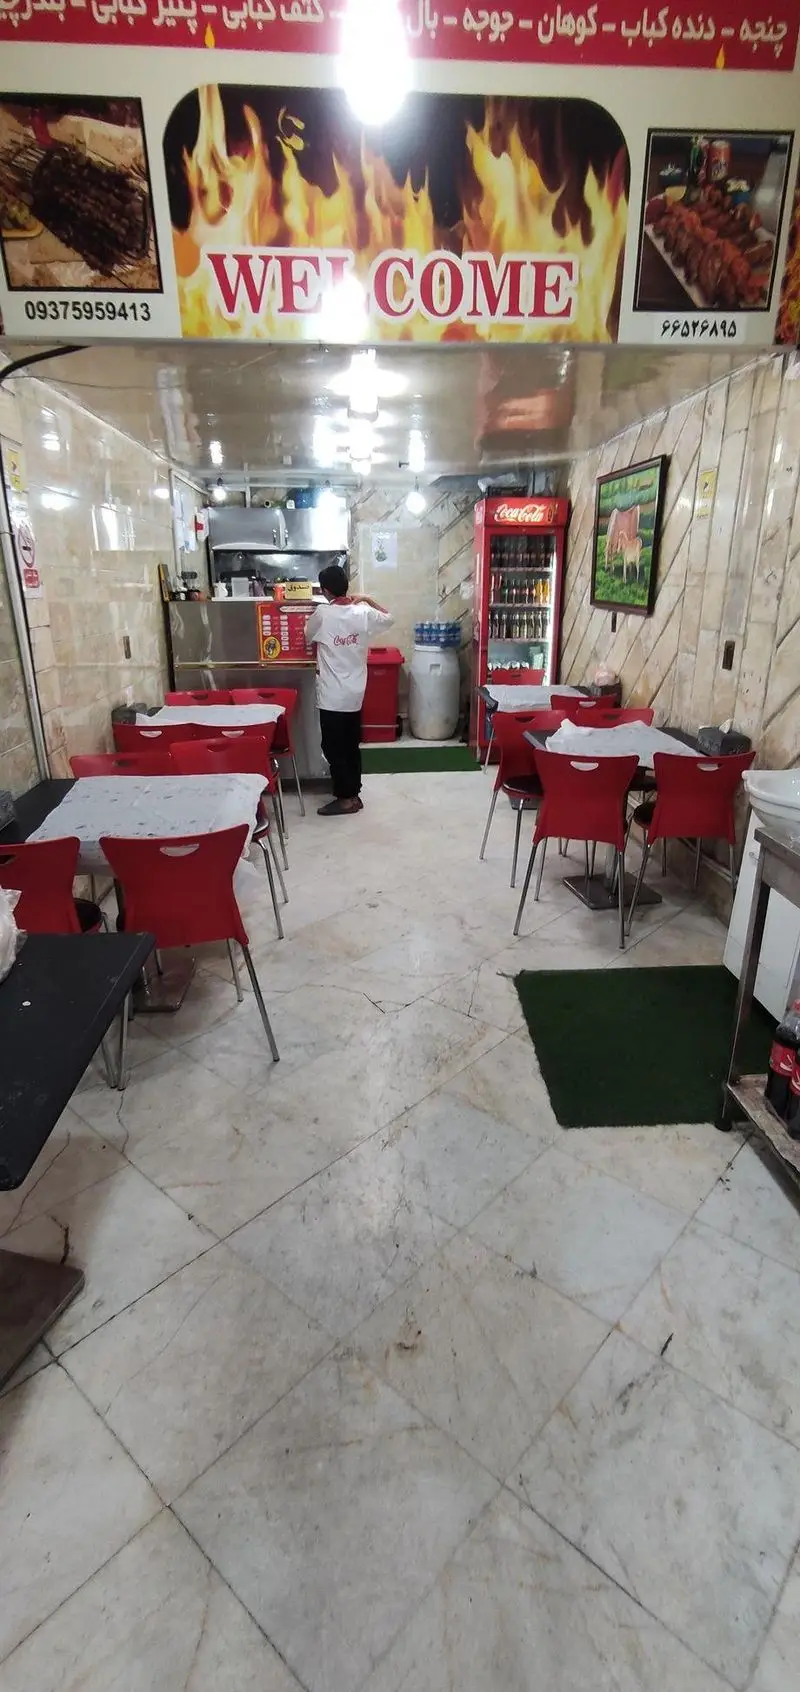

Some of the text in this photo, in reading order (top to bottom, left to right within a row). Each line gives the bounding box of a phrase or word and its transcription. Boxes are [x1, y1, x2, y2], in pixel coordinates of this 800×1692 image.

[462, 7, 513, 42] جوجه
[537, 4, 597, 45] کوهان
[621, 6, 669, 48] کباب
[671, 13, 715, 40] دنده
[739, 16, 787, 59] چنجه
[24, 300, 151, 321] 09375959413
